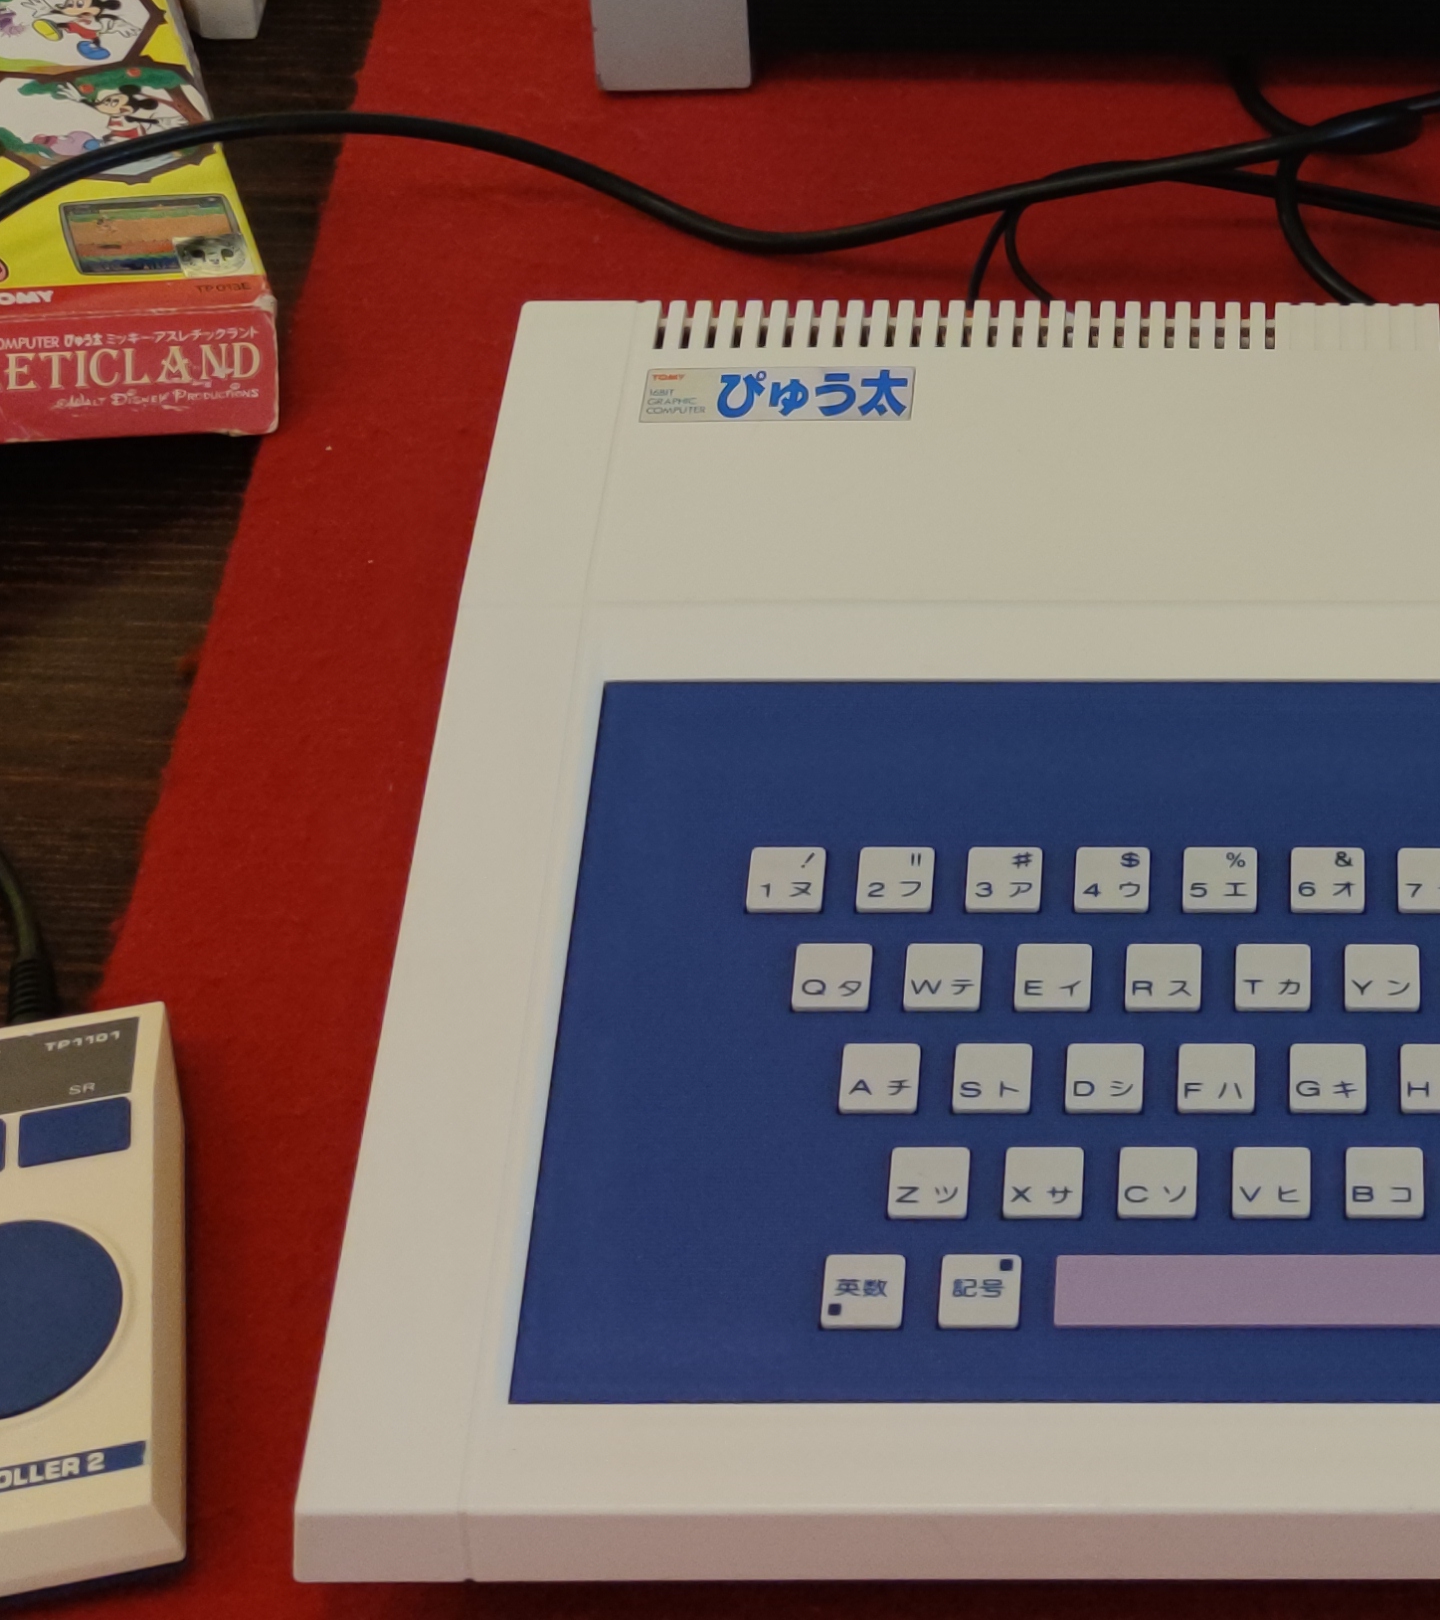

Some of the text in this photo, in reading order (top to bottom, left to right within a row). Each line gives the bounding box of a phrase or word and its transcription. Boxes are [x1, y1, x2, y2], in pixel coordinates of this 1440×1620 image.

[717, 369, 909, 418] ぴゅう太
[646, 405, 707, 415] COMPUTER
[760, 882, 771, 898] 1
[974, 881, 994, 898] 3
[1189, 882, 1208, 899] 5
[801, 978, 827, 996] Q
[910, 979, 943, 996] W
[1023, 979, 1044, 997] E
[1242, 978, 1264, 995] T
[42, 1028, 123, 1055] TP1101
[67, 1081, 97, 1098] SR
[848, 1078, 873, 1096] A
[959, 1080, 983, 1099] S
[1072, 1080, 1096, 1098] D
[1295, 1079, 1321, 1098] G
[894, 1185, 920, 1204] Z
[1123, 1185, 1149, 1204] C
[1351, 1185, 1375, 1203] B
[834, 1278, 888, 1298] 英数
[951, 1278, 1006, 1299] 記号
[85, 1452, 107, 1474] 2
